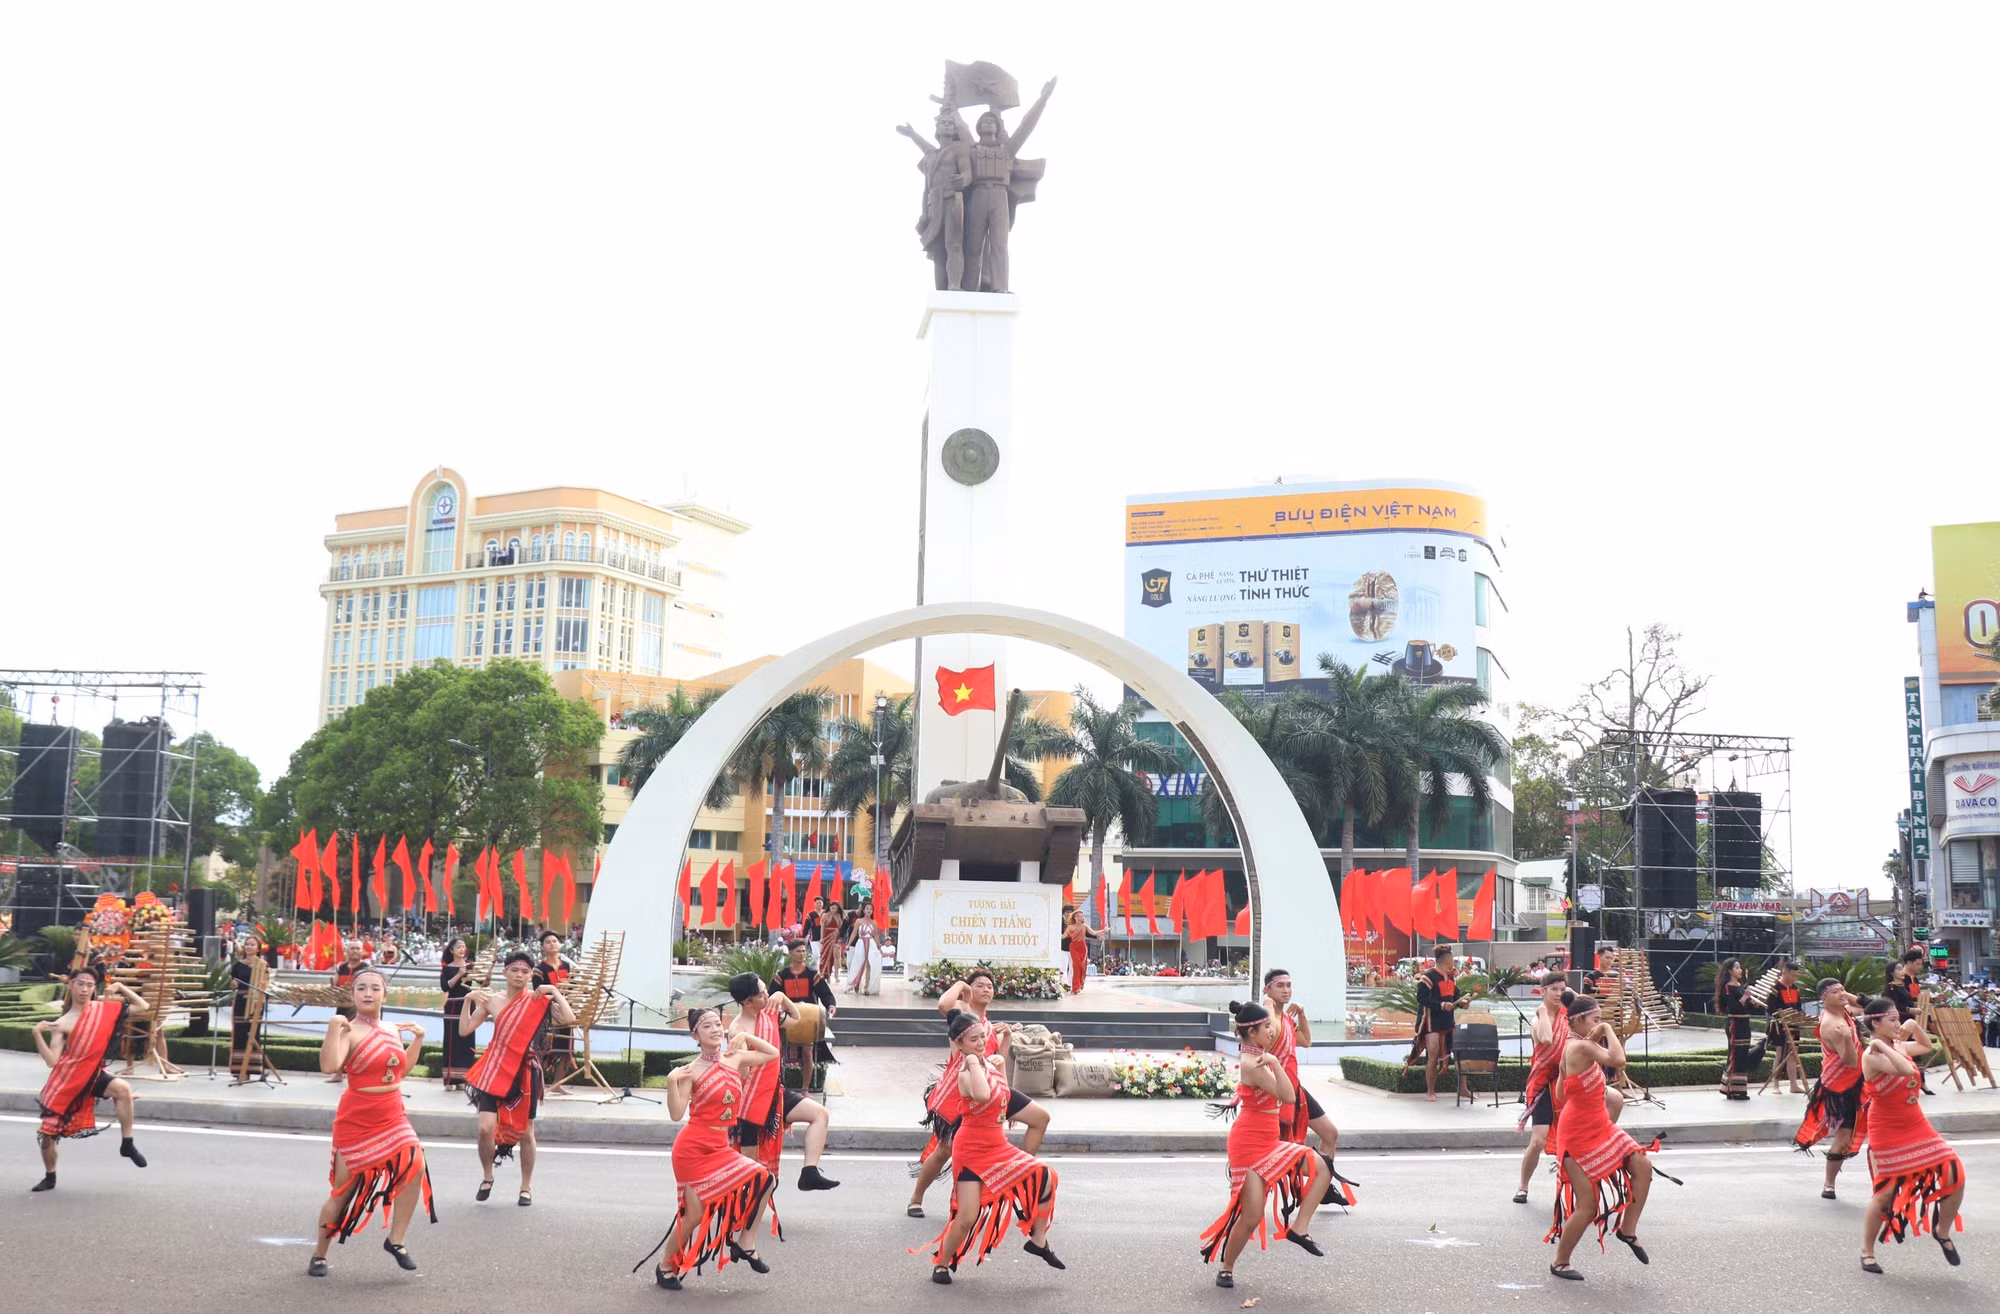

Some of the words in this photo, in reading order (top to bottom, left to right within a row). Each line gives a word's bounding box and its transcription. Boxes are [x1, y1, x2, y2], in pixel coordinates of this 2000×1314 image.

[1275, 508, 1314, 522] BƯU
[1319, 503, 1367, 520] ĐIỆN
[1372, 501, 1414, 518] VIỆT
[1419, 504, 1457, 519] NAM
[1239, 568, 1269, 583] THỨ
[1271, 566, 1309, 582] THIỆT
[1144, 576, 1169, 593] G7
[1274, 584, 1310, 599] THỨC
[1906, 692, 1921, 729] TÂN
[1909, 734, 1924, 784] THÁI
[1955, 797, 1997, 809] DAVACO
[1912, 789, 1927, 839] BÌNH
[1000, 898, 1017, 910] ĐÀI
[950, 912, 987, 928] CHIẾN
[992, 913, 1032, 929] THẮNG
[942, 930, 974, 945] BUÔN
[978, 933, 998, 946] MA
[1000, 931, 1039, 949] THUỘT
